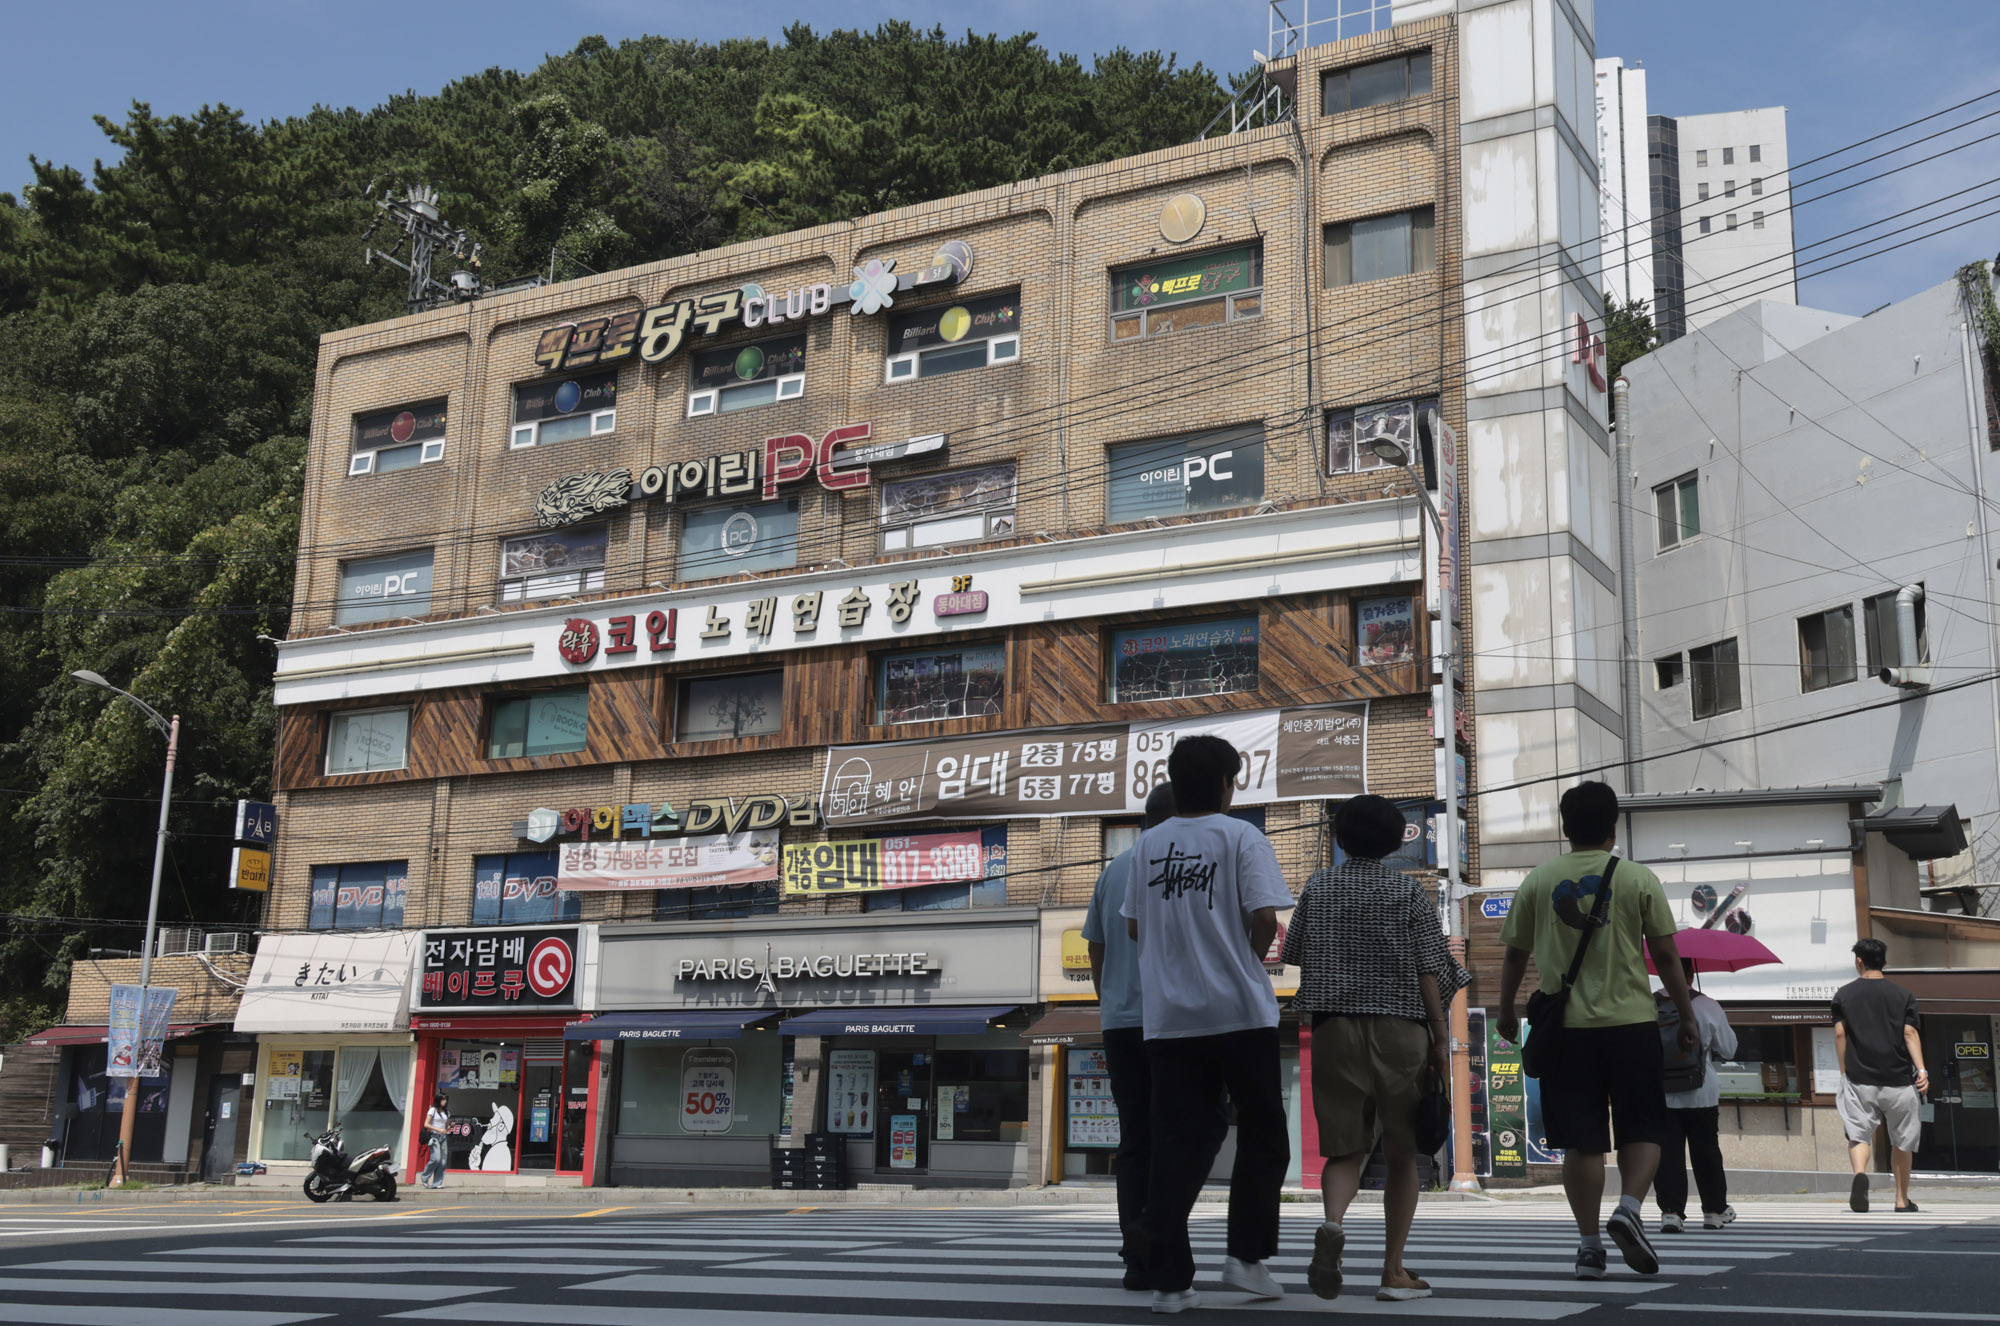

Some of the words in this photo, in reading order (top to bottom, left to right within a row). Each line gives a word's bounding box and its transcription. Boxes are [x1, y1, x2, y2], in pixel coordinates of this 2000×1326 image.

[743, 283, 832, 328] CLUB
[903, 325, 937, 340] Billiard
[975, 313, 997, 328] Club
[703, 364, 734, 382] Billiard
[766, 352, 788, 369] Club
[584, 386, 602, 403] Club
[951, 575, 974, 592] 3F
[937, 593, 984, 613] 동아대점
[605, 607, 678, 656] 코인
[1026, 743, 1059, 766] 2층
[1071, 738, 1118, 763] 75평
[936, 750, 1010, 800] 임대
[1023, 776, 1057, 800] 5층
[1069, 771, 1116, 796] 77평
[563, 801, 681, 841] 아이맥스
[684, 793, 789, 838] DVD
[565, 848, 598, 872] 설빙
[602, 848, 664, 871] 가맹점주
[668, 845, 699, 867] 모집
[814, 842, 879, 892] 임대
[884, 843, 980, 886] 817-3388
[336, 886, 385, 911] DVD
[424, 937, 524, 968] 전자담배
[294, 960, 357, 988] きたい
[677, 958, 754, 982] PARIS
[777, 952, 928, 982] BAGUETTE
[310, 991, 329, 1001] KITAI
[422, 970, 525, 1002] 베이프큐
[643, 1029, 681, 1037] BAGUETTE
[846, 1025, 869, 1033] PARIS
[872, 1025, 915, 1034] BAGUETTE
[694, 1055, 731, 1063] membership
[1957, 1046, 1988, 1056] OPEN
[1491, 1063, 1520, 1075] 백프로
[1492, 1075, 1518, 1090] 당구
[715, 1106, 730, 1114] OFF
[1503, 1134, 1512, 1144] 5F
